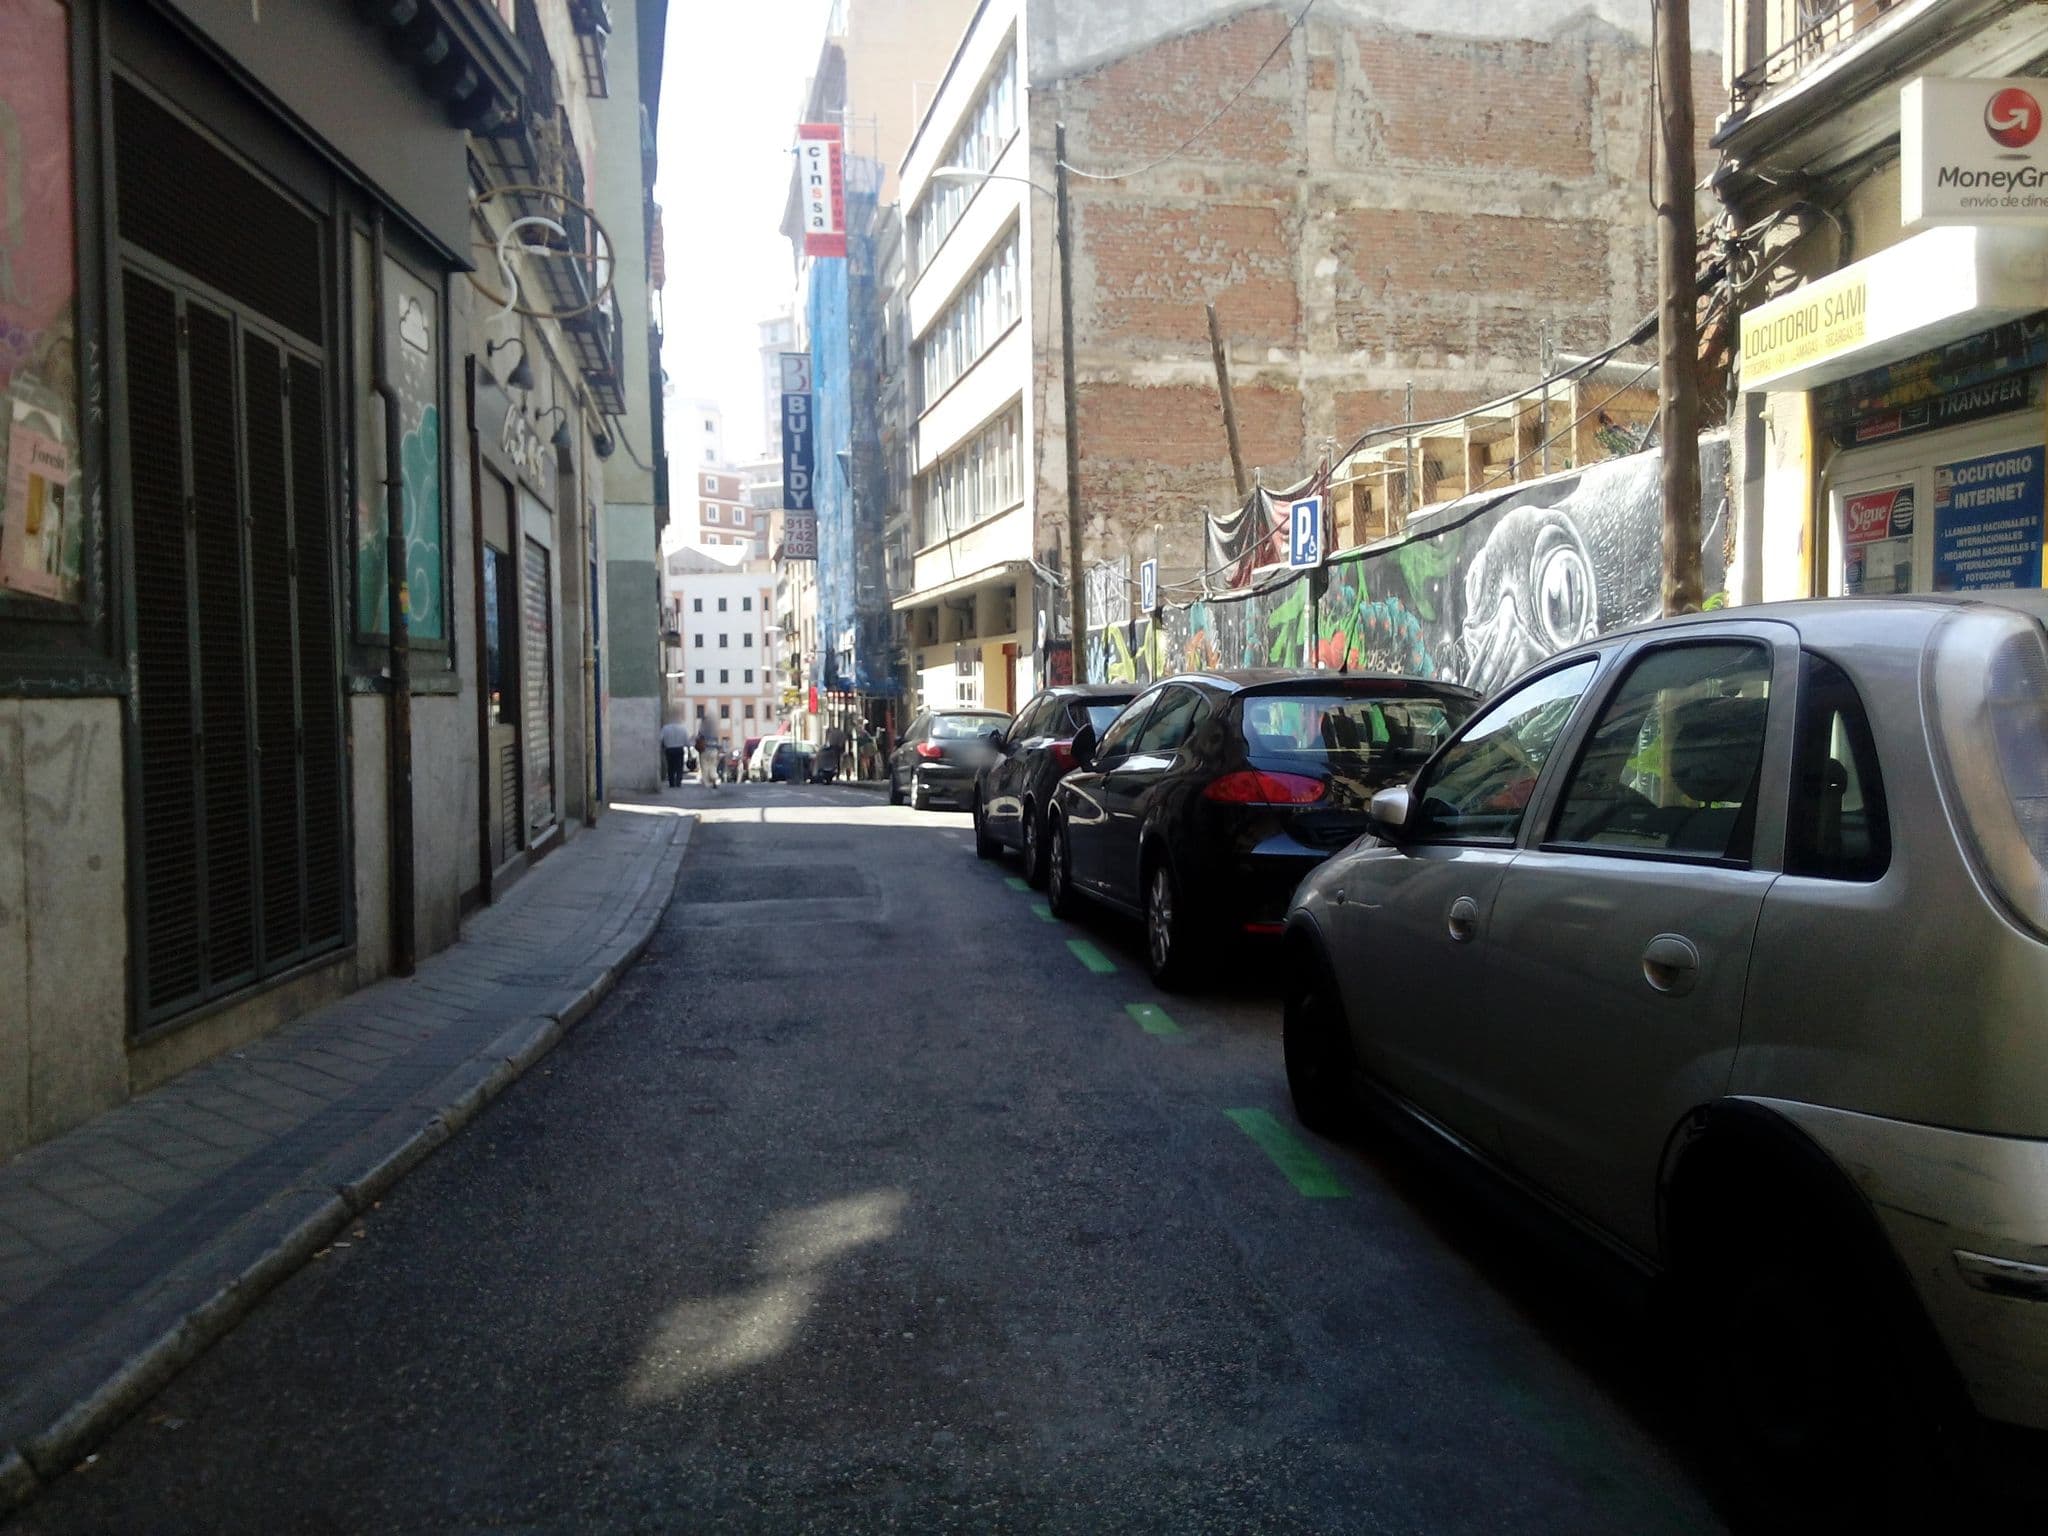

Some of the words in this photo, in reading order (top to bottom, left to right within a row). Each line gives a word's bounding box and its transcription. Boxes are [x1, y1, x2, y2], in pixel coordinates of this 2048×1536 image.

[2000, 195, 2019, 208] de
[1745, 304, 1819, 361] LOCUTORIO
[1824, 283, 1866, 328] SAMI
[1938, 376, 2022, 418] TRANSFER
[788, 395, 807, 508] BUILDY
[1954, 481, 2026, 510] INTERNET
[787, 518, 813, 529] 915
[1848, 502, 1888, 532] Sigue
[787, 531, 813, 542] 742
[1297, 506, 1312, 556] P
[1956, 530, 2023, 548] INTERNACIONALES
[787, 543, 813, 555] 602
[1955, 555, 2023, 571] INTERNACIONALES
[1144, 566, 1151, 601] P
[1965, 569, 2012, 582] FOTOCOPIAS
